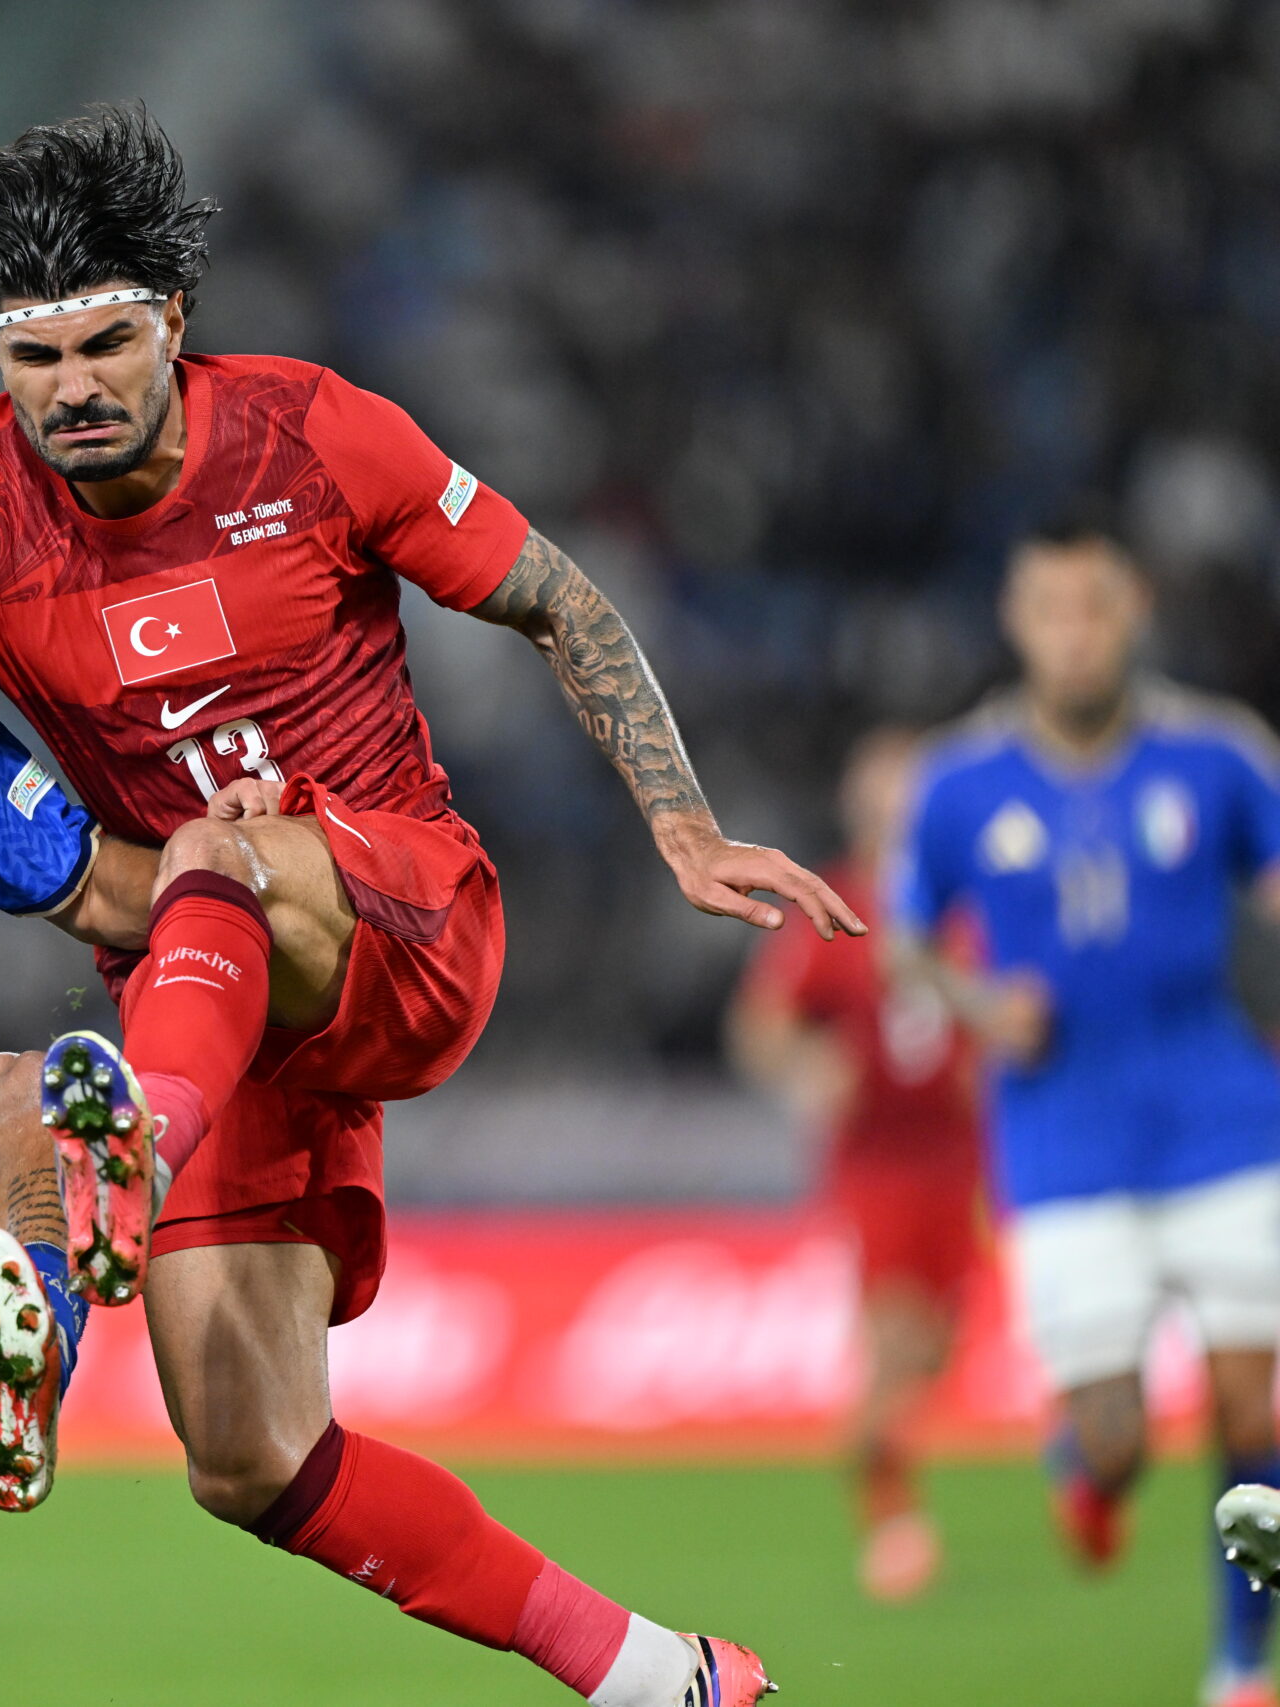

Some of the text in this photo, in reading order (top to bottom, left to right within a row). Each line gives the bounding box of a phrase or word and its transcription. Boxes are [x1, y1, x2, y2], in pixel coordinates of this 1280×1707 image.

[441, 487, 454, 507] UEFA
[214, 510, 248, 530] İTALYA
[252, 498, 294, 520] TÜRKİYE
[230, 520, 287, 546] 05 EKİM 2026
[166, 718, 286, 802] 13
